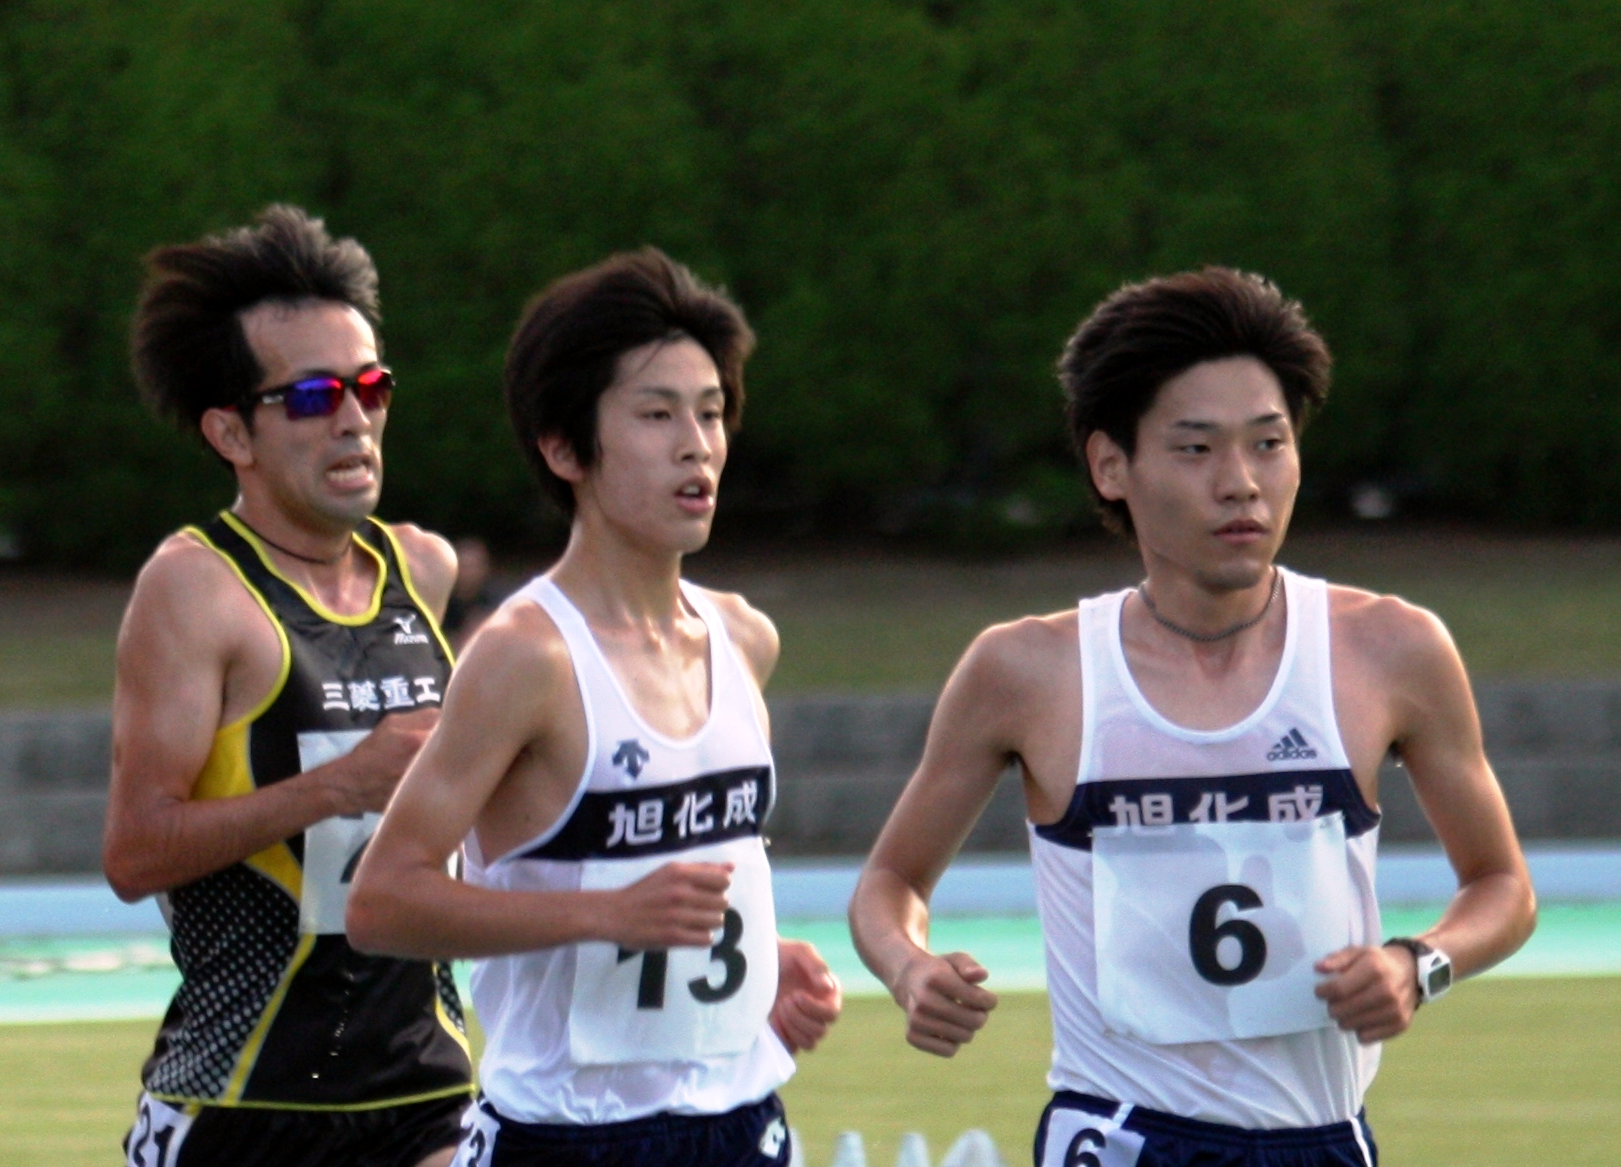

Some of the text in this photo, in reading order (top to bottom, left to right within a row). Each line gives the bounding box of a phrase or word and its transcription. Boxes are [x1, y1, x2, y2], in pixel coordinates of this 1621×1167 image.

[1267, 748, 1317, 762] adidas
[607, 779, 759, 849] 旭化成
[1188, 884, 1267, 987] 6
